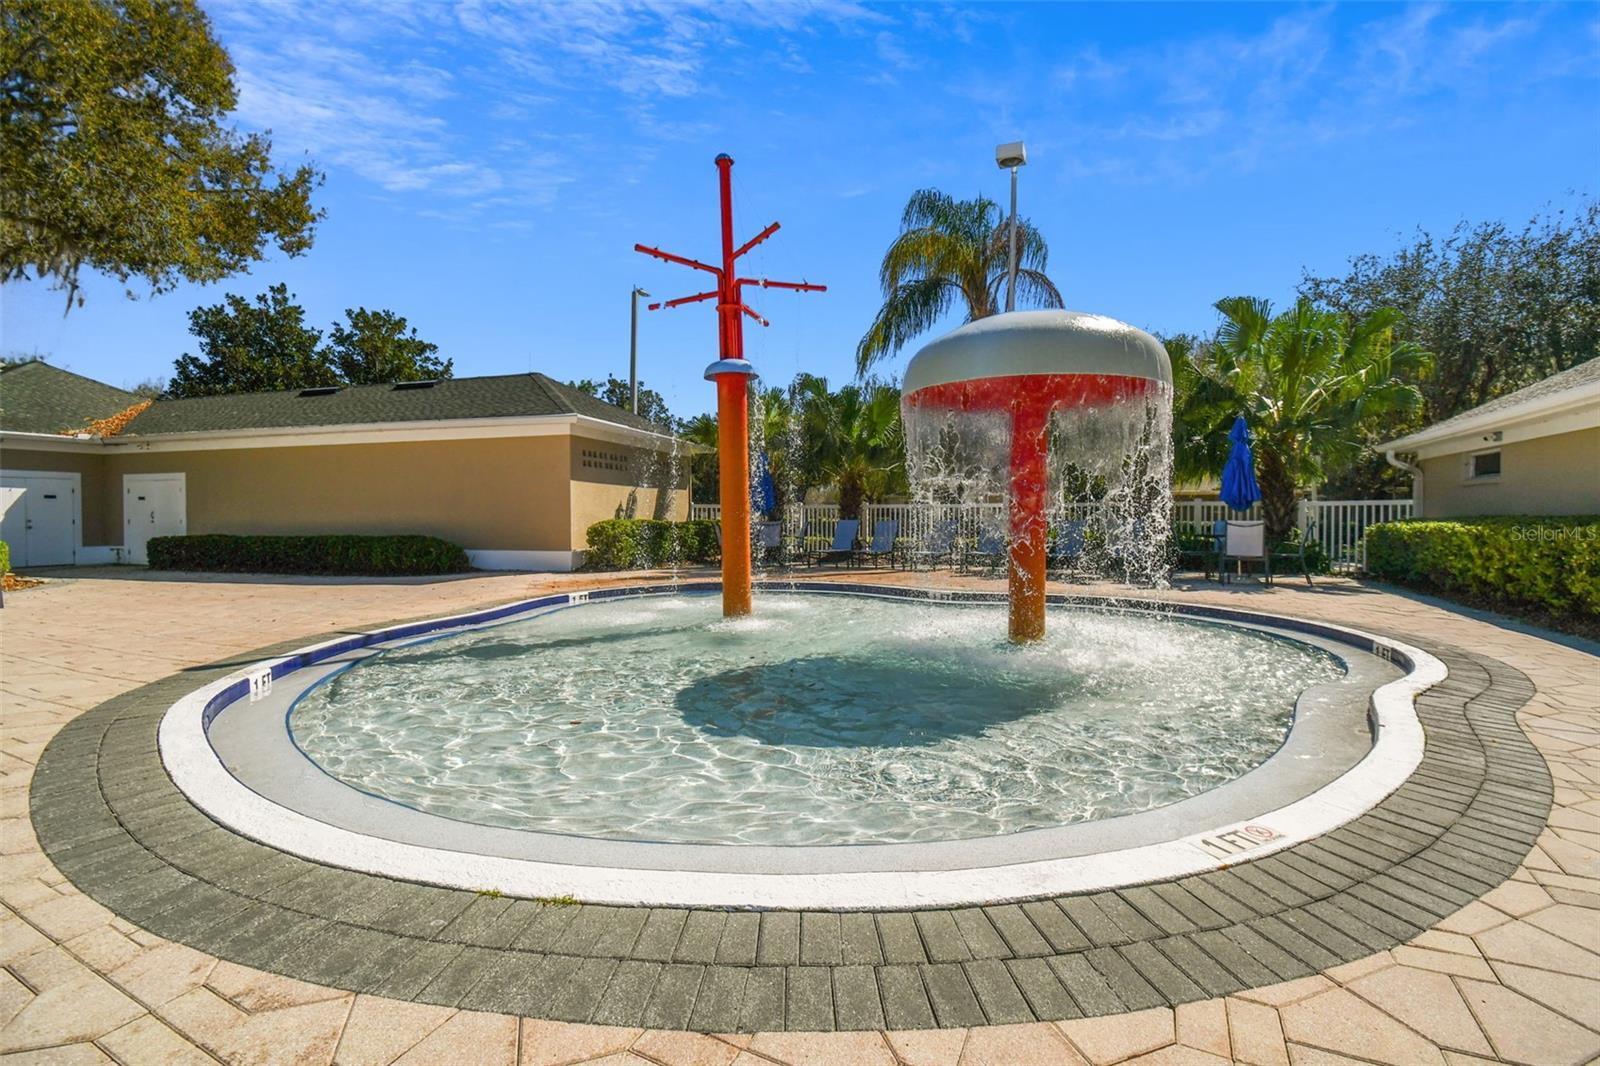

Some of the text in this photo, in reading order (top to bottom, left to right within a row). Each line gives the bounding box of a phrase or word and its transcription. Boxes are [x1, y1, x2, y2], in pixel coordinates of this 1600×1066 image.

[254, 672, 271, 690] 1 FT
[1201, 839, 1232, 855] 1
[1215, 829, 1260, 850] FT
